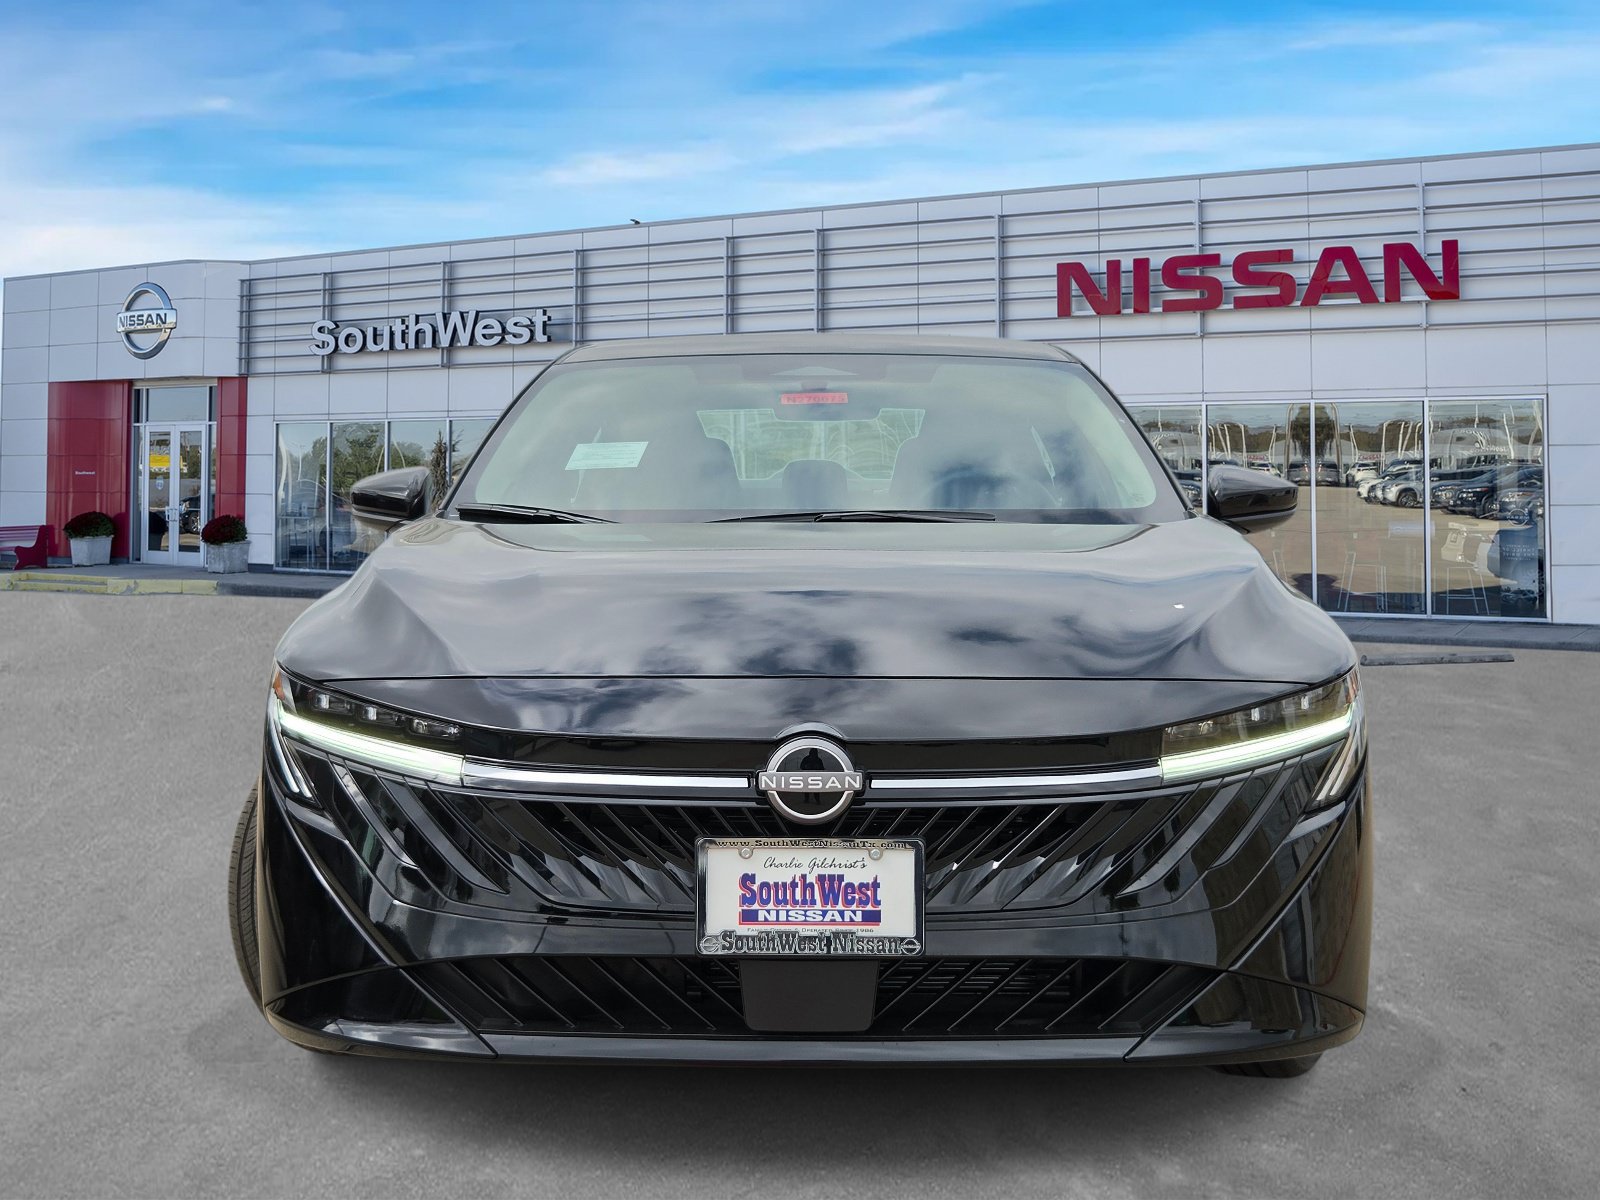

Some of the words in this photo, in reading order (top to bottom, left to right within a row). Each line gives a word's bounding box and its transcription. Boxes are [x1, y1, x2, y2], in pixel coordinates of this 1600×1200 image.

[1056, 239, 1460, 317] NISSAN
[119, 312, 167, 328] NISSAN
[309, 308, 551, 356] SouthWest
[761, 775, 860, 789] NISSAN
[763, 857, 804, 869] Charlie
[807, 857, 867, 874] Gilchrist's
[738, 872, 881, 908] SouthWest
[757, 910, 863, 922] NISSAN
[831, 931, 900, 954] Nissan
